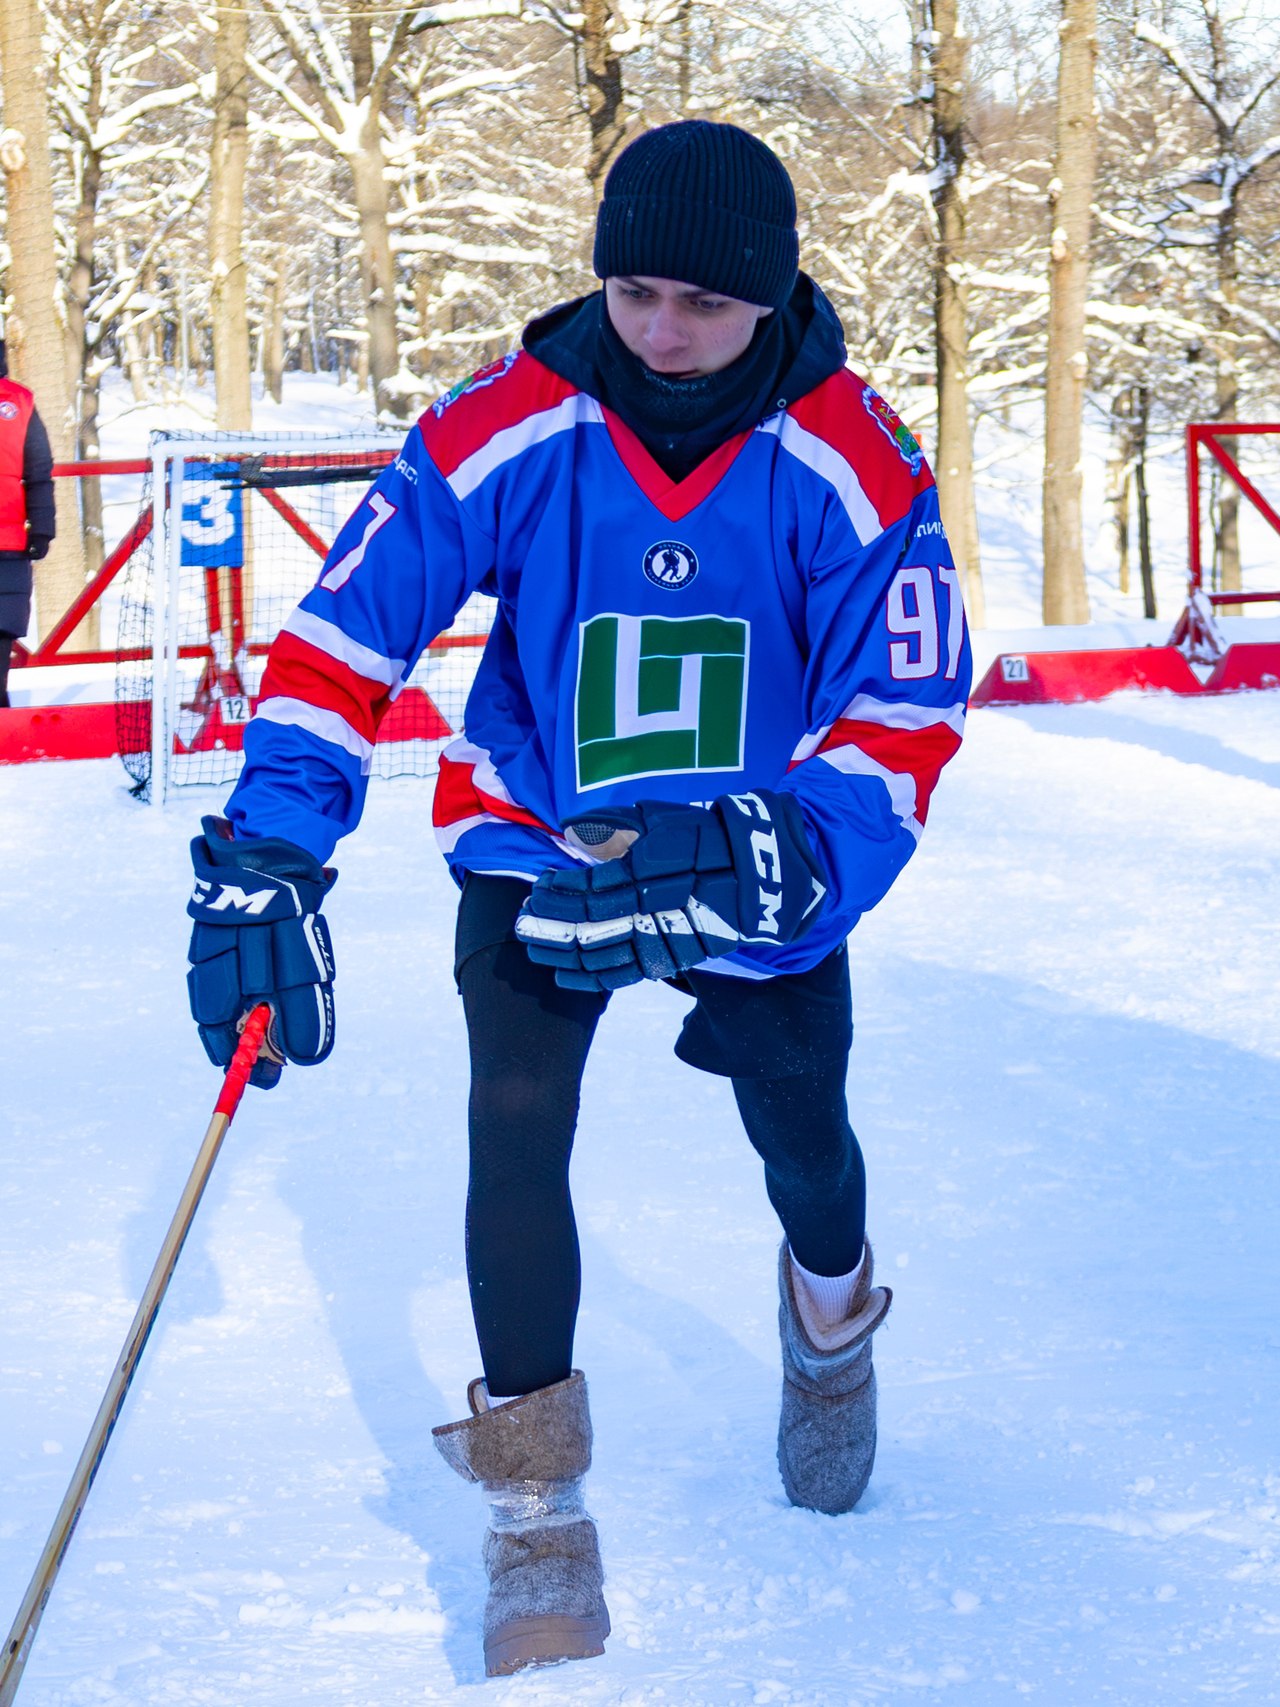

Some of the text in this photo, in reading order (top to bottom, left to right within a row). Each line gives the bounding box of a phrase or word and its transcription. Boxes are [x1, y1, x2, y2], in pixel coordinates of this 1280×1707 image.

[181, 480, 236, 546] 3
[885, 565, 966, 681] 97
[226, 700, 246, 720] 12
[727, 791, 783, 936] CCM
